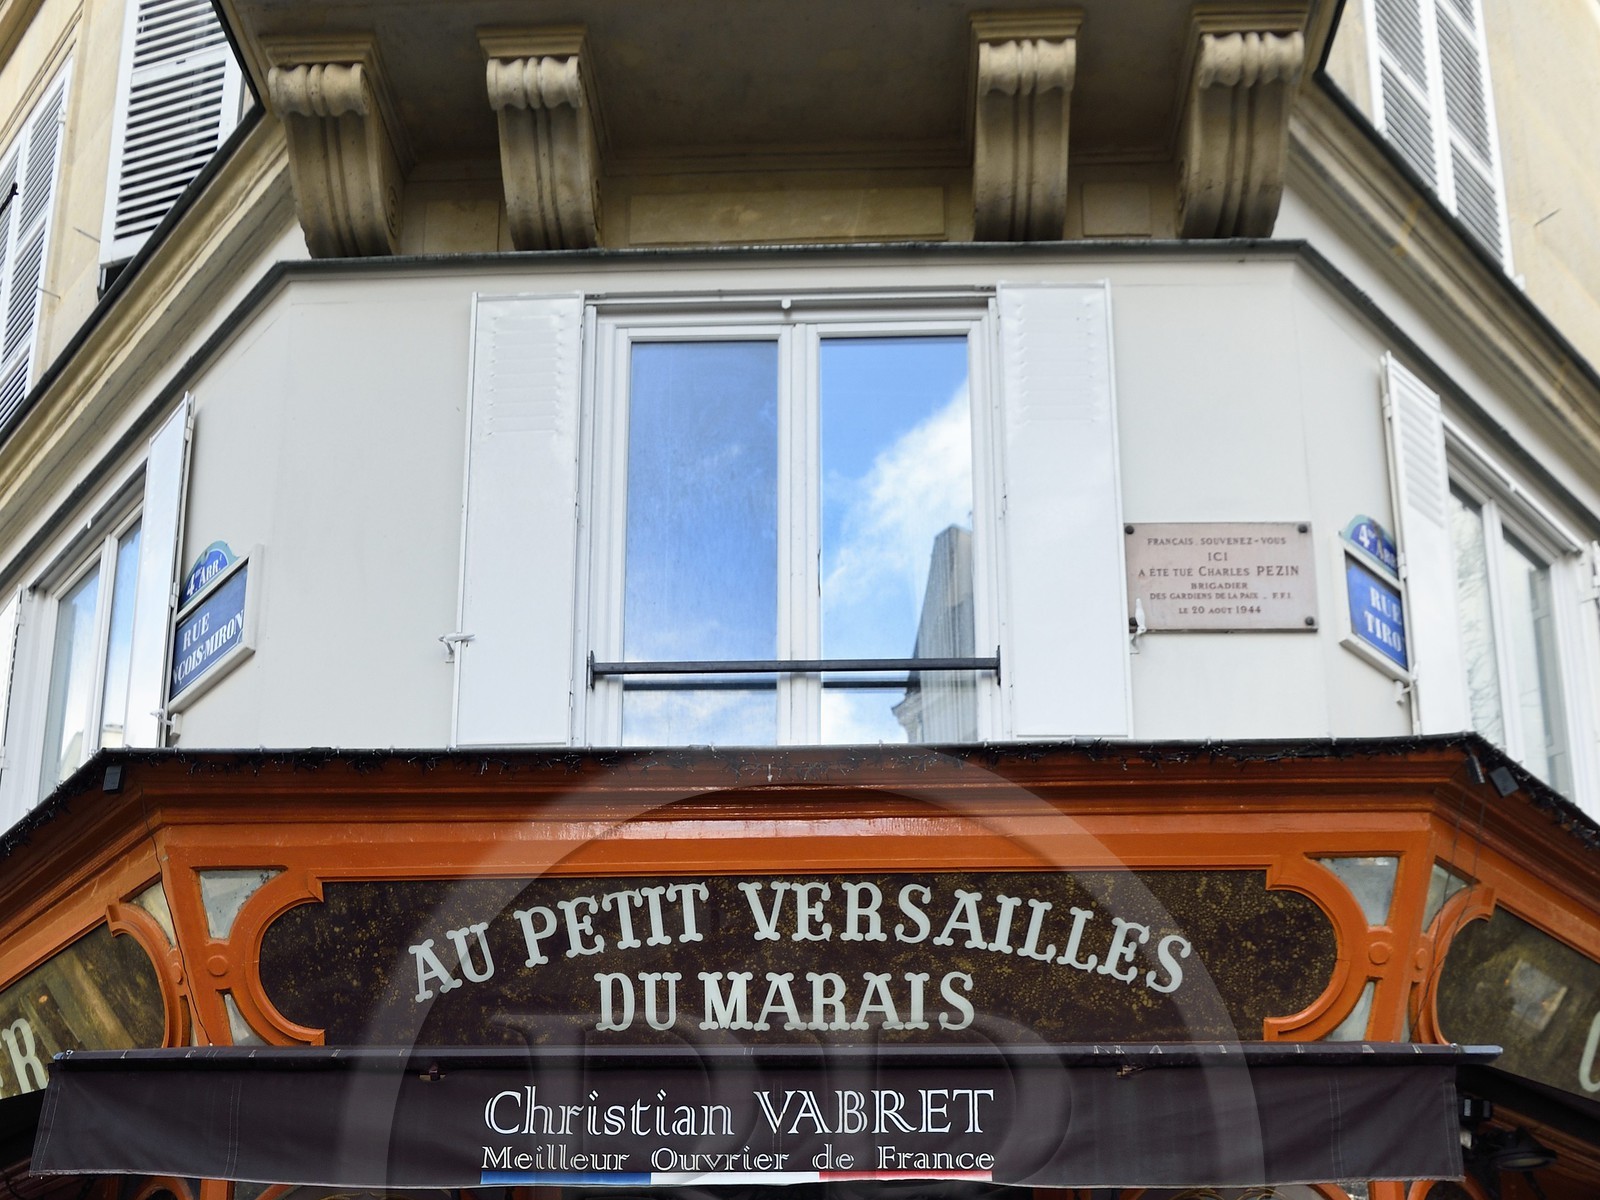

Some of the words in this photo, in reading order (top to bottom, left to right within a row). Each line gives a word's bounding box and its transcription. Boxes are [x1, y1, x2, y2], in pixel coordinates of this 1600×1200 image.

[1138, 568, 1146, 577] A
[1256, 565, 1299, 577] PEZIN
[1207, 552, 1228, 561] ICI
[1149, 592, 1167, 600] DES
[1169, 592, 1212, 600] GARDIENS
[1215, 592, 1226, 600] DE
[1227, 592, 1238, 600] LA
[1239, 592, 1258, 600] PAIX
[1190, 582, 1248, 590] BRIGADIER
[1178, 607, 1188, 615] LE
[1191, 606, 1205, 615] 20
[1236, 605, 1261, 615] 1944
[1370, 586, 1402, 625] RUE
[183, 612, 210, 652] RUE
[1364, 610, 1406, 652] TIRO
[408, 921, 496, 1003] AU
[513, 881, 710, 968] PETIT
[737, 881, 1192, 994] VERSAILLES
[594, 971, 682, 1032] DU
[697, 971, 976, 1032] MARAIS
[484, 1085, 735, 1136] Christian
[753, 1089, 995, 1134] VABRET
[481, 1144, 630, 1170] Meilleur
[651, 1145, 789, 1171] Ouvrier
[812, 1143, 855, 1170] de
[876, 1145, 995, 1170] France
